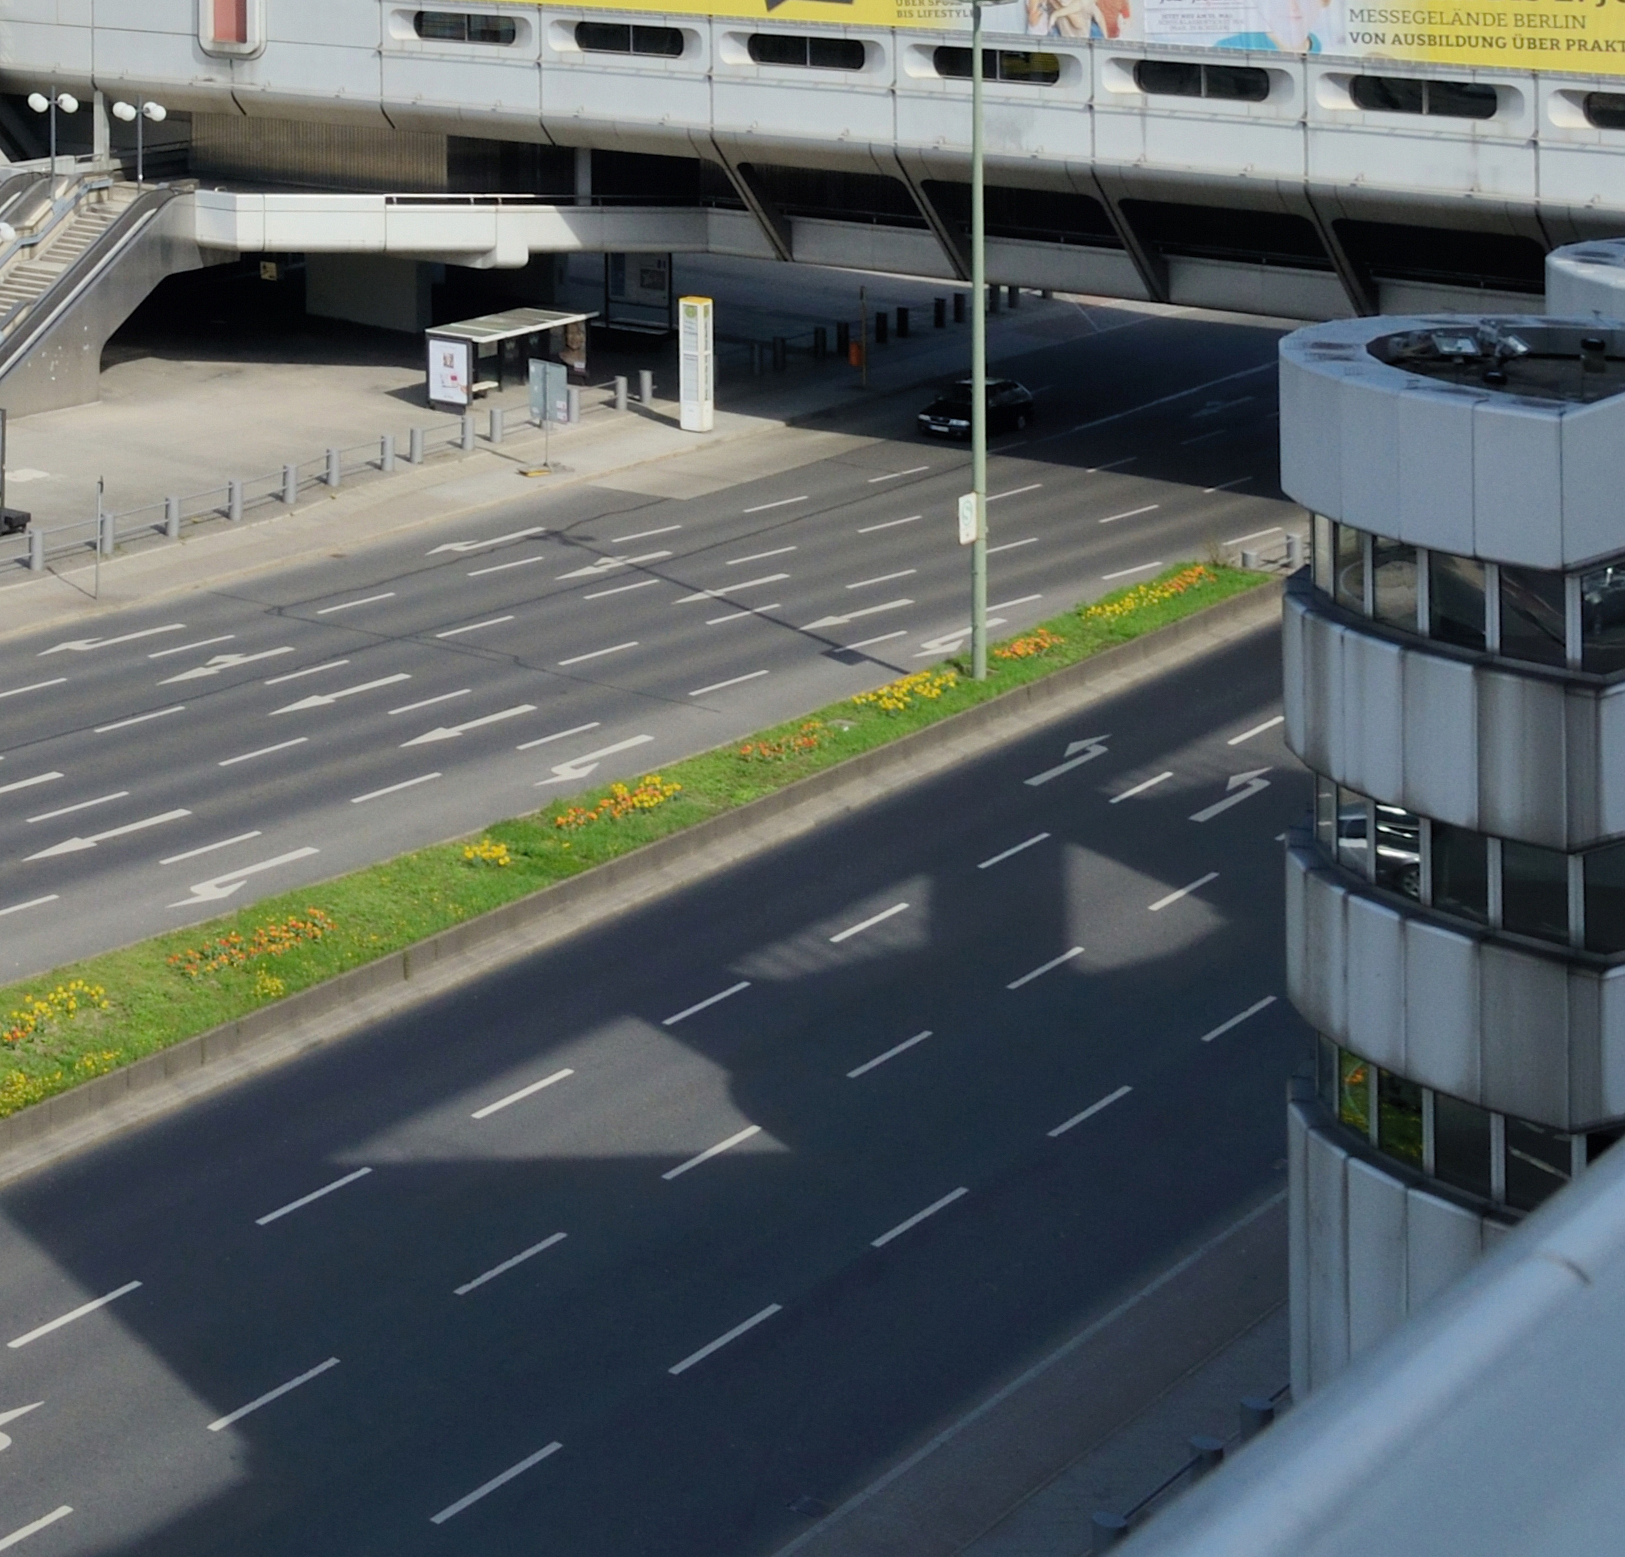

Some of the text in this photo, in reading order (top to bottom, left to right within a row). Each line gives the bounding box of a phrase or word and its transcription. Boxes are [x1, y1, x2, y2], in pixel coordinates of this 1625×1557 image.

[897, 9, 914, 18] BIS
[1349, 8, 1586, 29] MESSEGELÄNDE BERLIN
[1349, 31, 1386, 45] VON
[1391, 33, 1507, 49] AUSBILDUNG
[1512, 33, 1561, 51] ÜBER
